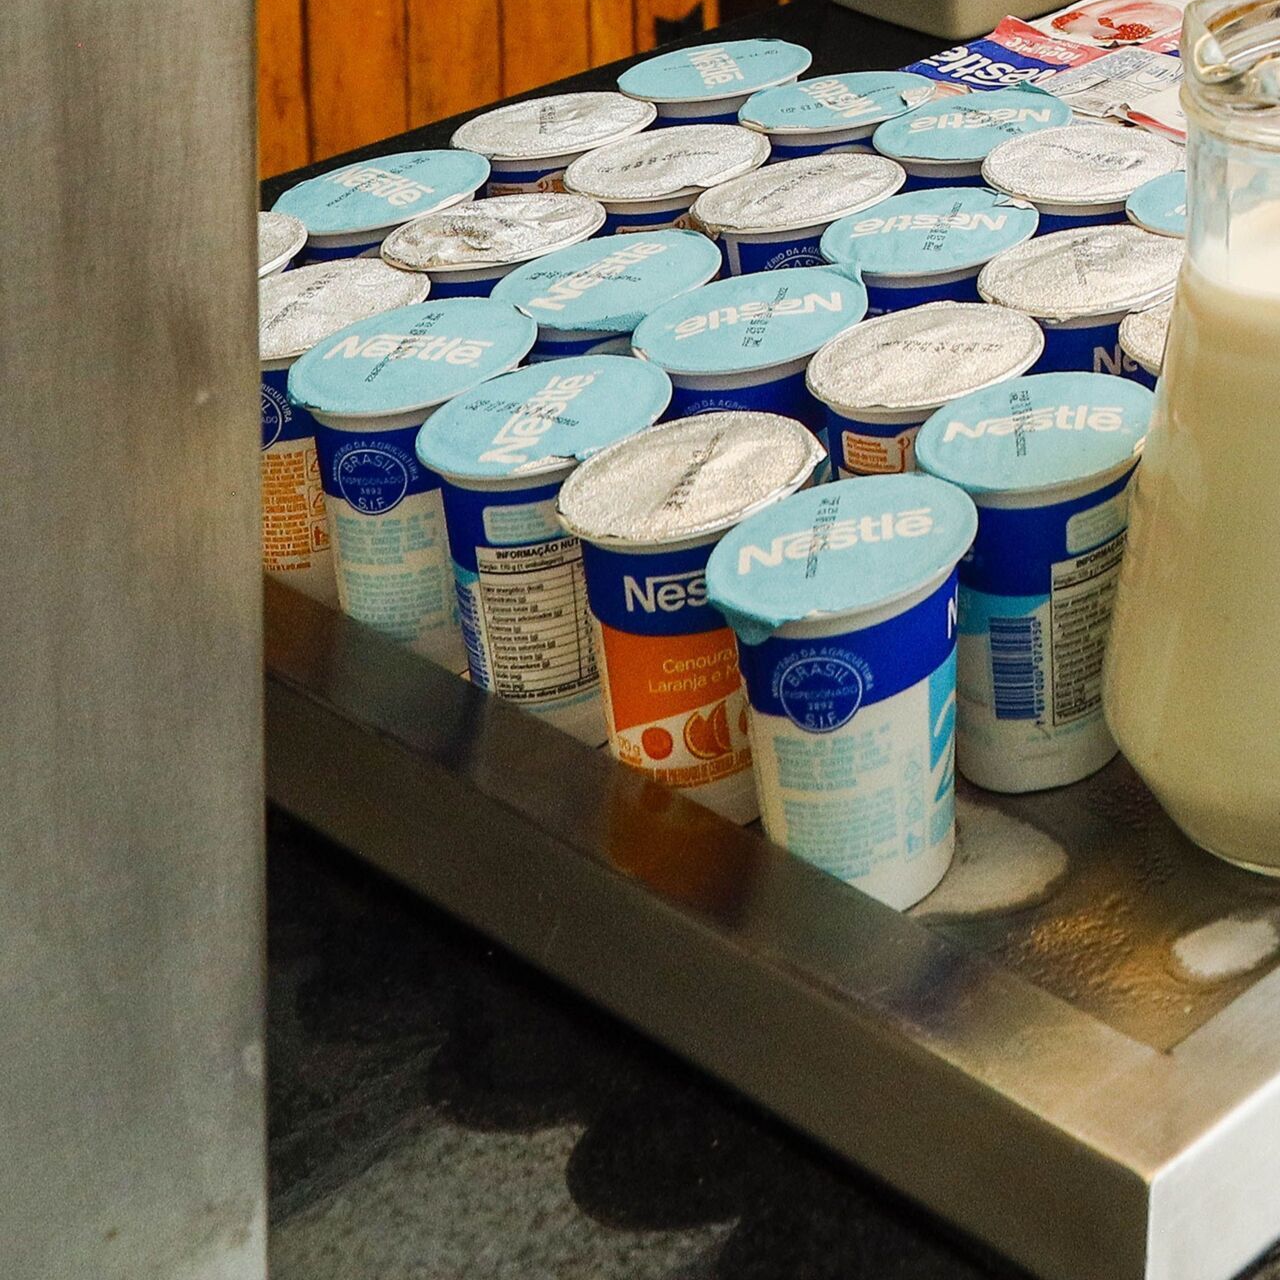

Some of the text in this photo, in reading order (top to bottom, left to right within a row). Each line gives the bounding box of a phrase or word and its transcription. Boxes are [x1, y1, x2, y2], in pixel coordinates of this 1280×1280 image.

[851, 213, 1008, 238] Nestlé
[528, 242, 667, 311] Nestlé
[674, 292, 842, 341] Nestlé
[323, 334, 494, 366] Nestlé
[478, 370, 600, 464] Nestlé
[943, 405, 1124, 443] Nestlé
[343, 454, 395, 475] BRASIL
[737, 507, 934, 576] Nestlé
[786, 662, 848, 687] BRASIL
